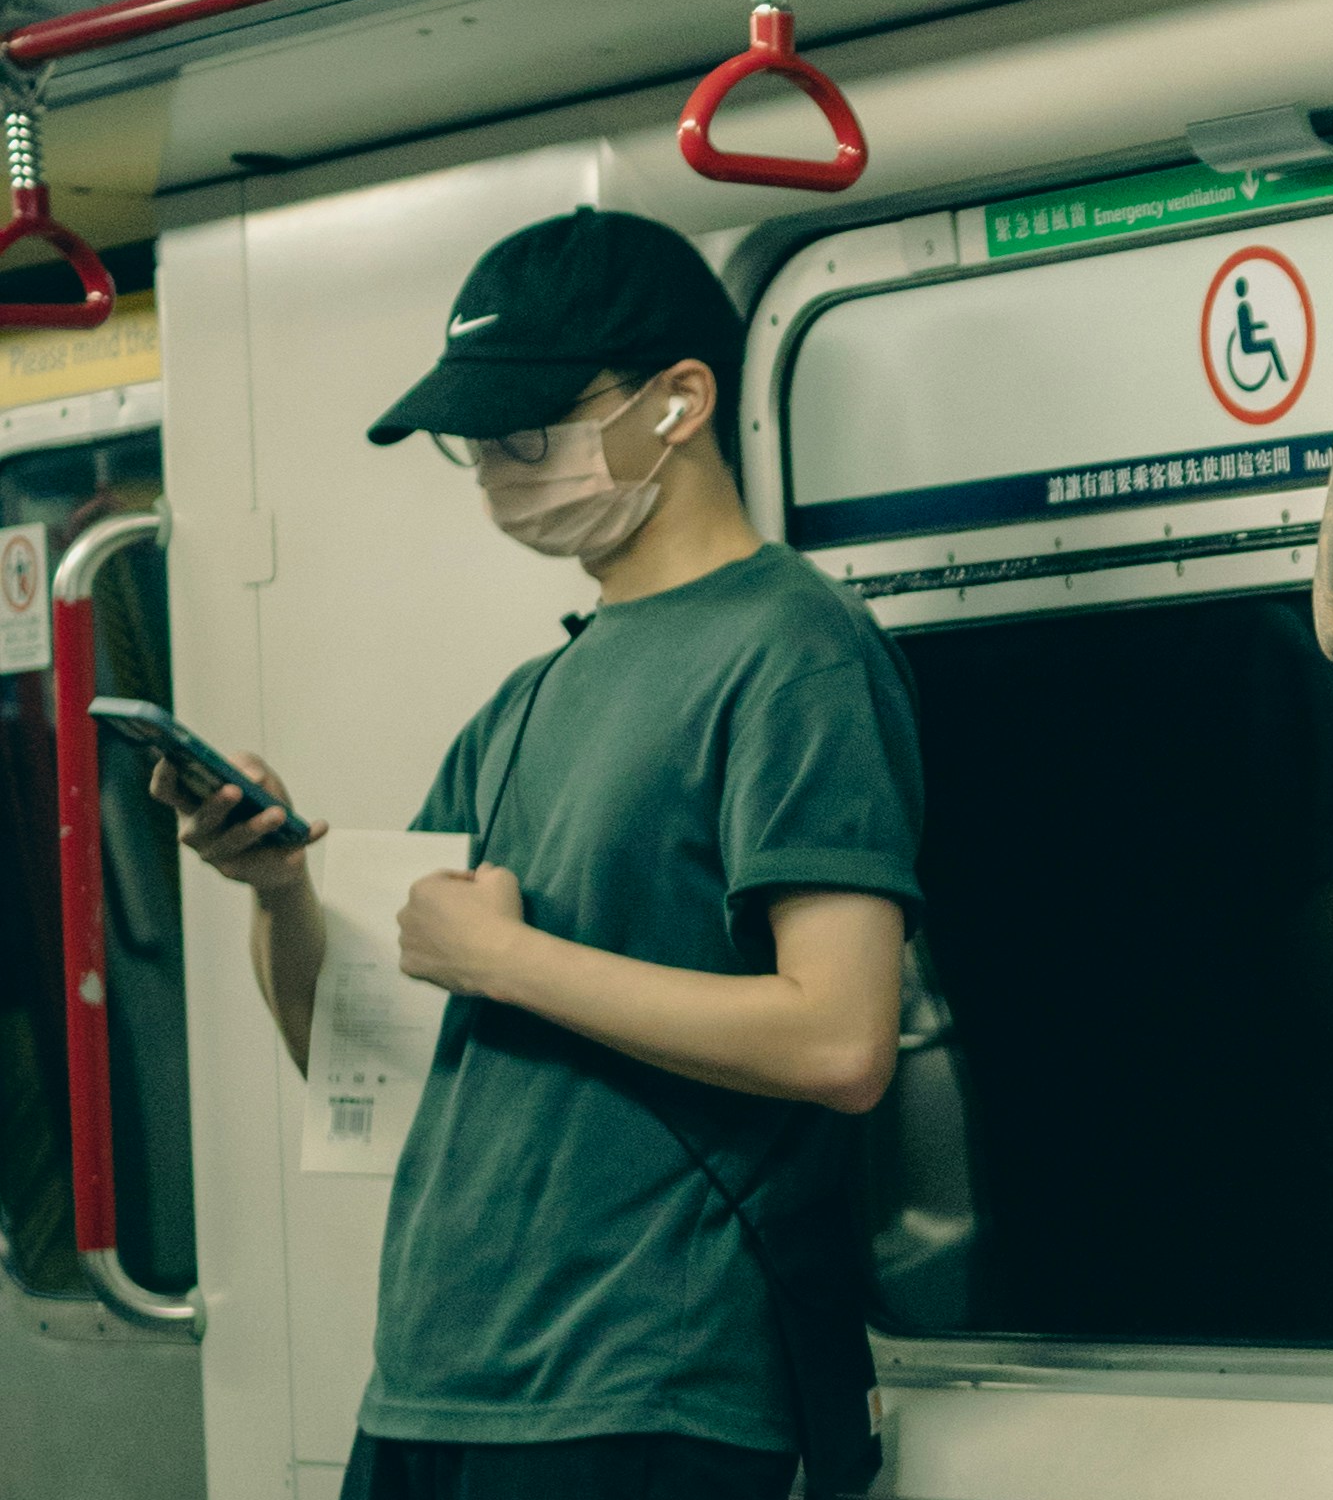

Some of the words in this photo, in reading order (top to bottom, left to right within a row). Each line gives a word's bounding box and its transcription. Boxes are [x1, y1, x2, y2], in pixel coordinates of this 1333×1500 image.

[1094, 200, 1164, 226] Emergency
[1167, 185, 1236, 212] ventilation
[1047, 445, 1291, 503] 請讓有需要乘客優先使用這空間
